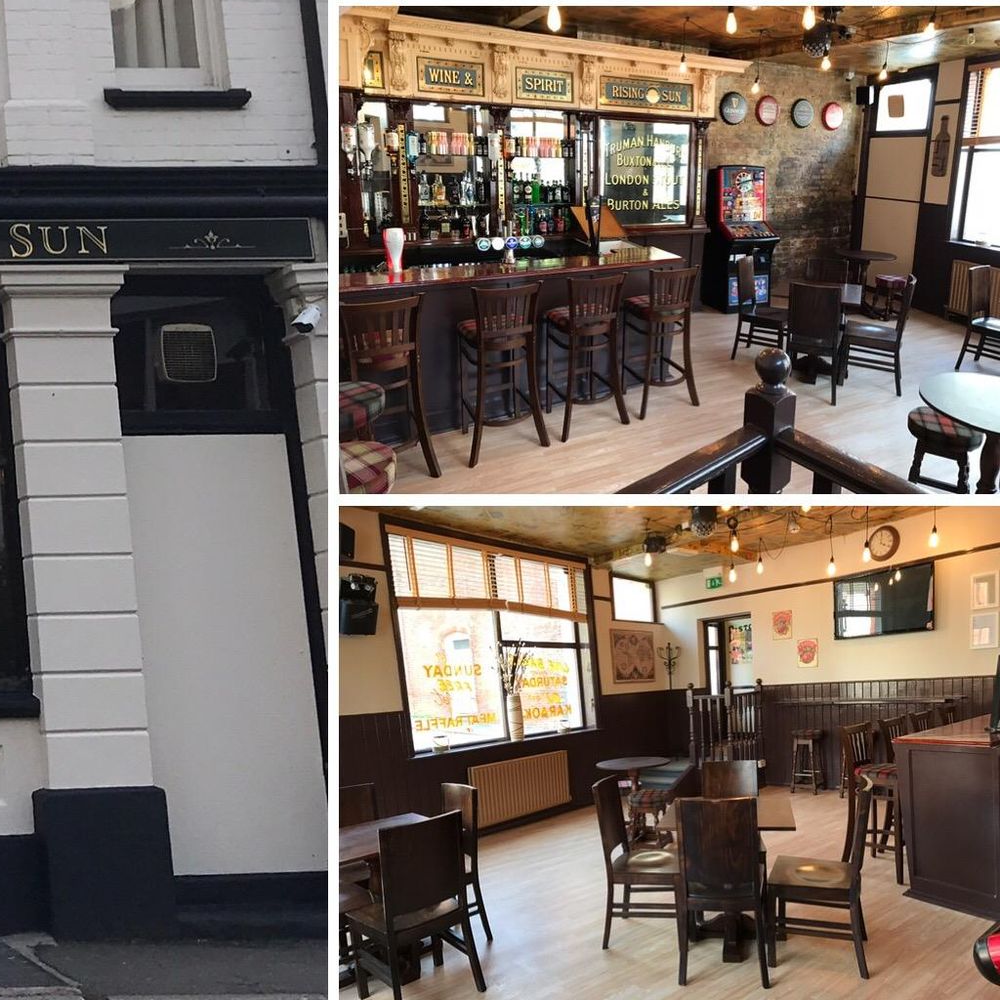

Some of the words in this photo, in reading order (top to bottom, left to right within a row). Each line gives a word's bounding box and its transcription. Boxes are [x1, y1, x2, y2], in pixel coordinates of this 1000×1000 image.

[428, 68, 461, 85] WINE
[464, 72, 473, 87] &
[524, 77, 564, 93] SPIRIT
[612, 85, 645, 100] RISING
[661, 90, 682, 103] SUN
[604, 136, 644, 157] TRUMAN
[617, 153, 652, 167] BUXTON
[605, 172, 649, 185] LONDON
[642, 188, 649, 197] &
[607, 198, 648, 211] BURTON
[652, 199, 681, 210] ALES
[9, 222, 110, 258] SUN
